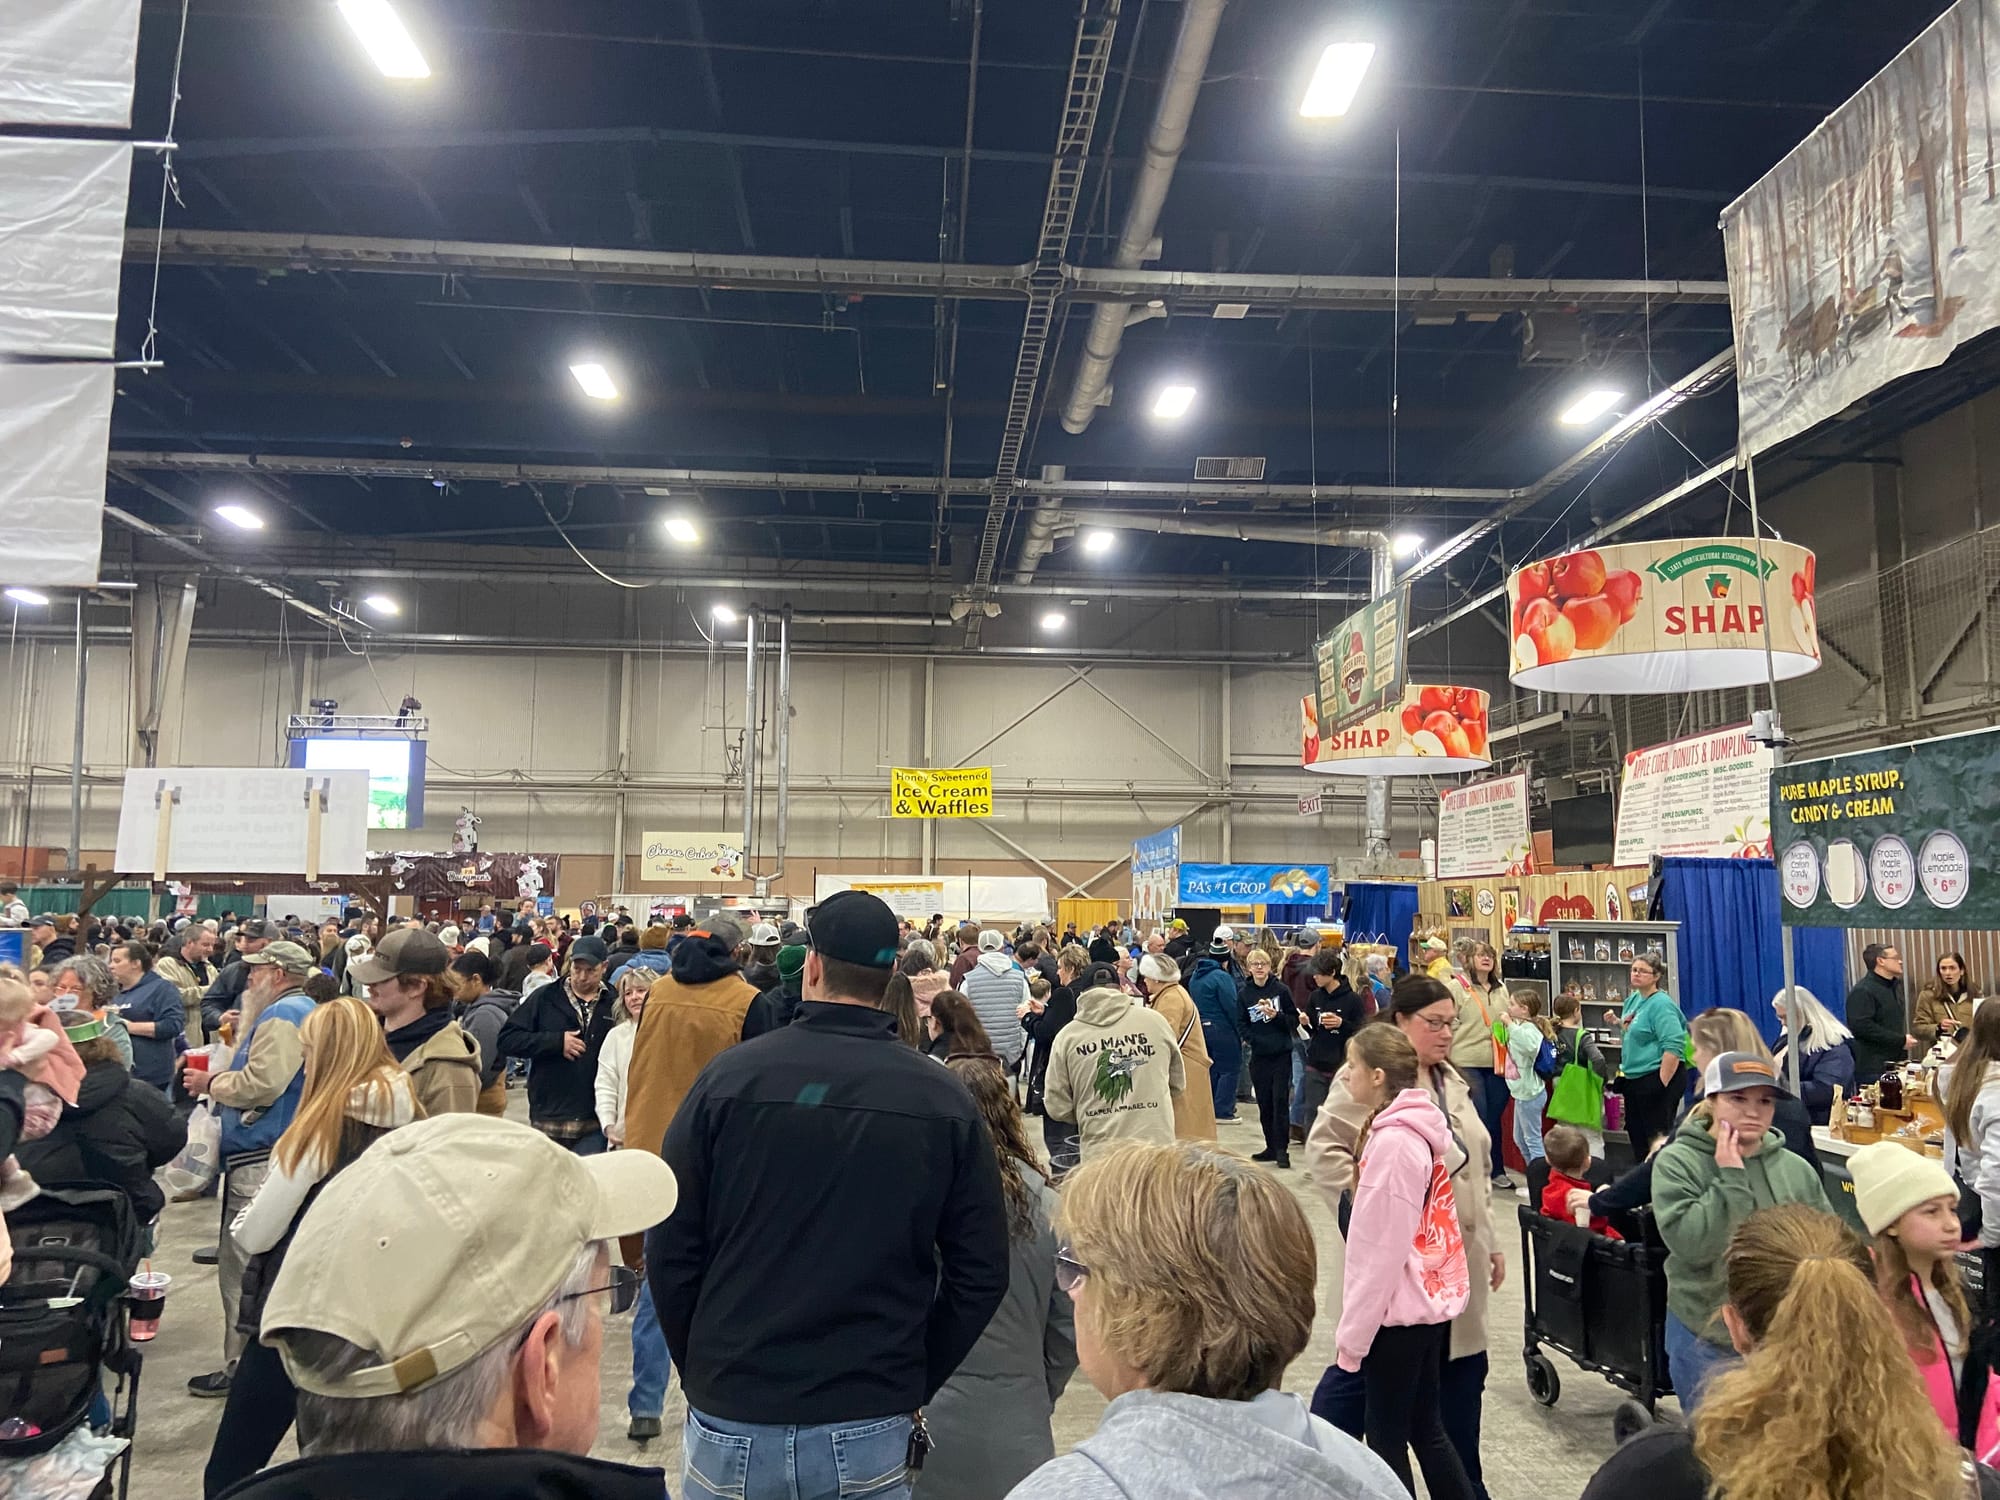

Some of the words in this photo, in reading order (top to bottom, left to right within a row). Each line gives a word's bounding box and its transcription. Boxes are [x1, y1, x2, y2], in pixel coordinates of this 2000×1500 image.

[1668, 561, 1683, 573] STATE
[1665, 605, 1764, 634] SHAP
[1331, 729, 1390, 751] SHAP
[1633, 756, 1650, 779] APPLE
[1672, 744, 1699, 770] DONUTS
[1702, 742, 1707, 762] &
[896, 772, 928, 783] Honey
[932, 771, 988, 781] Sweetened
[896, 784, 922, 798] Ice
[928, 784, 988, 798] Cream
[1780, 783, 1806, 801] PURE
[1807, 776, 1850, 798] MAPLE
[1855, 769, 1905, 792] SYRUP,
[896, 800, 912, 814] &
[918, 799, 989, 815] Waffles
[1302, 797, 1320, 814] EXIT
[1791, 804, 1828, 824] CANDY
[1831, 803, 1842, 819] &
[1846, 797, 1894, 818] CREAM
[647, 843, 684, 860] Cheese
[685, 847, 719, 860] Cubes
[1877, 849, 1902, 858] Frozen
[1931, 852, 1955, 862] Maple
[1880, 860, 1901, 869] Maple
[1923, 862, 1963, 874] Lemonade
[1791, 869, 1809, 879] Candy
[1187, 881, 1212, 894] PA's
[1214, 882, 1227, 894] #1
[1229, 882, 1266, 895] CROP
[1557, 908, 1580, 920] SHAP
[1076, 1043, 1097, 1057] NO
[1101, 1033, 1148, 1051] MAN'S
